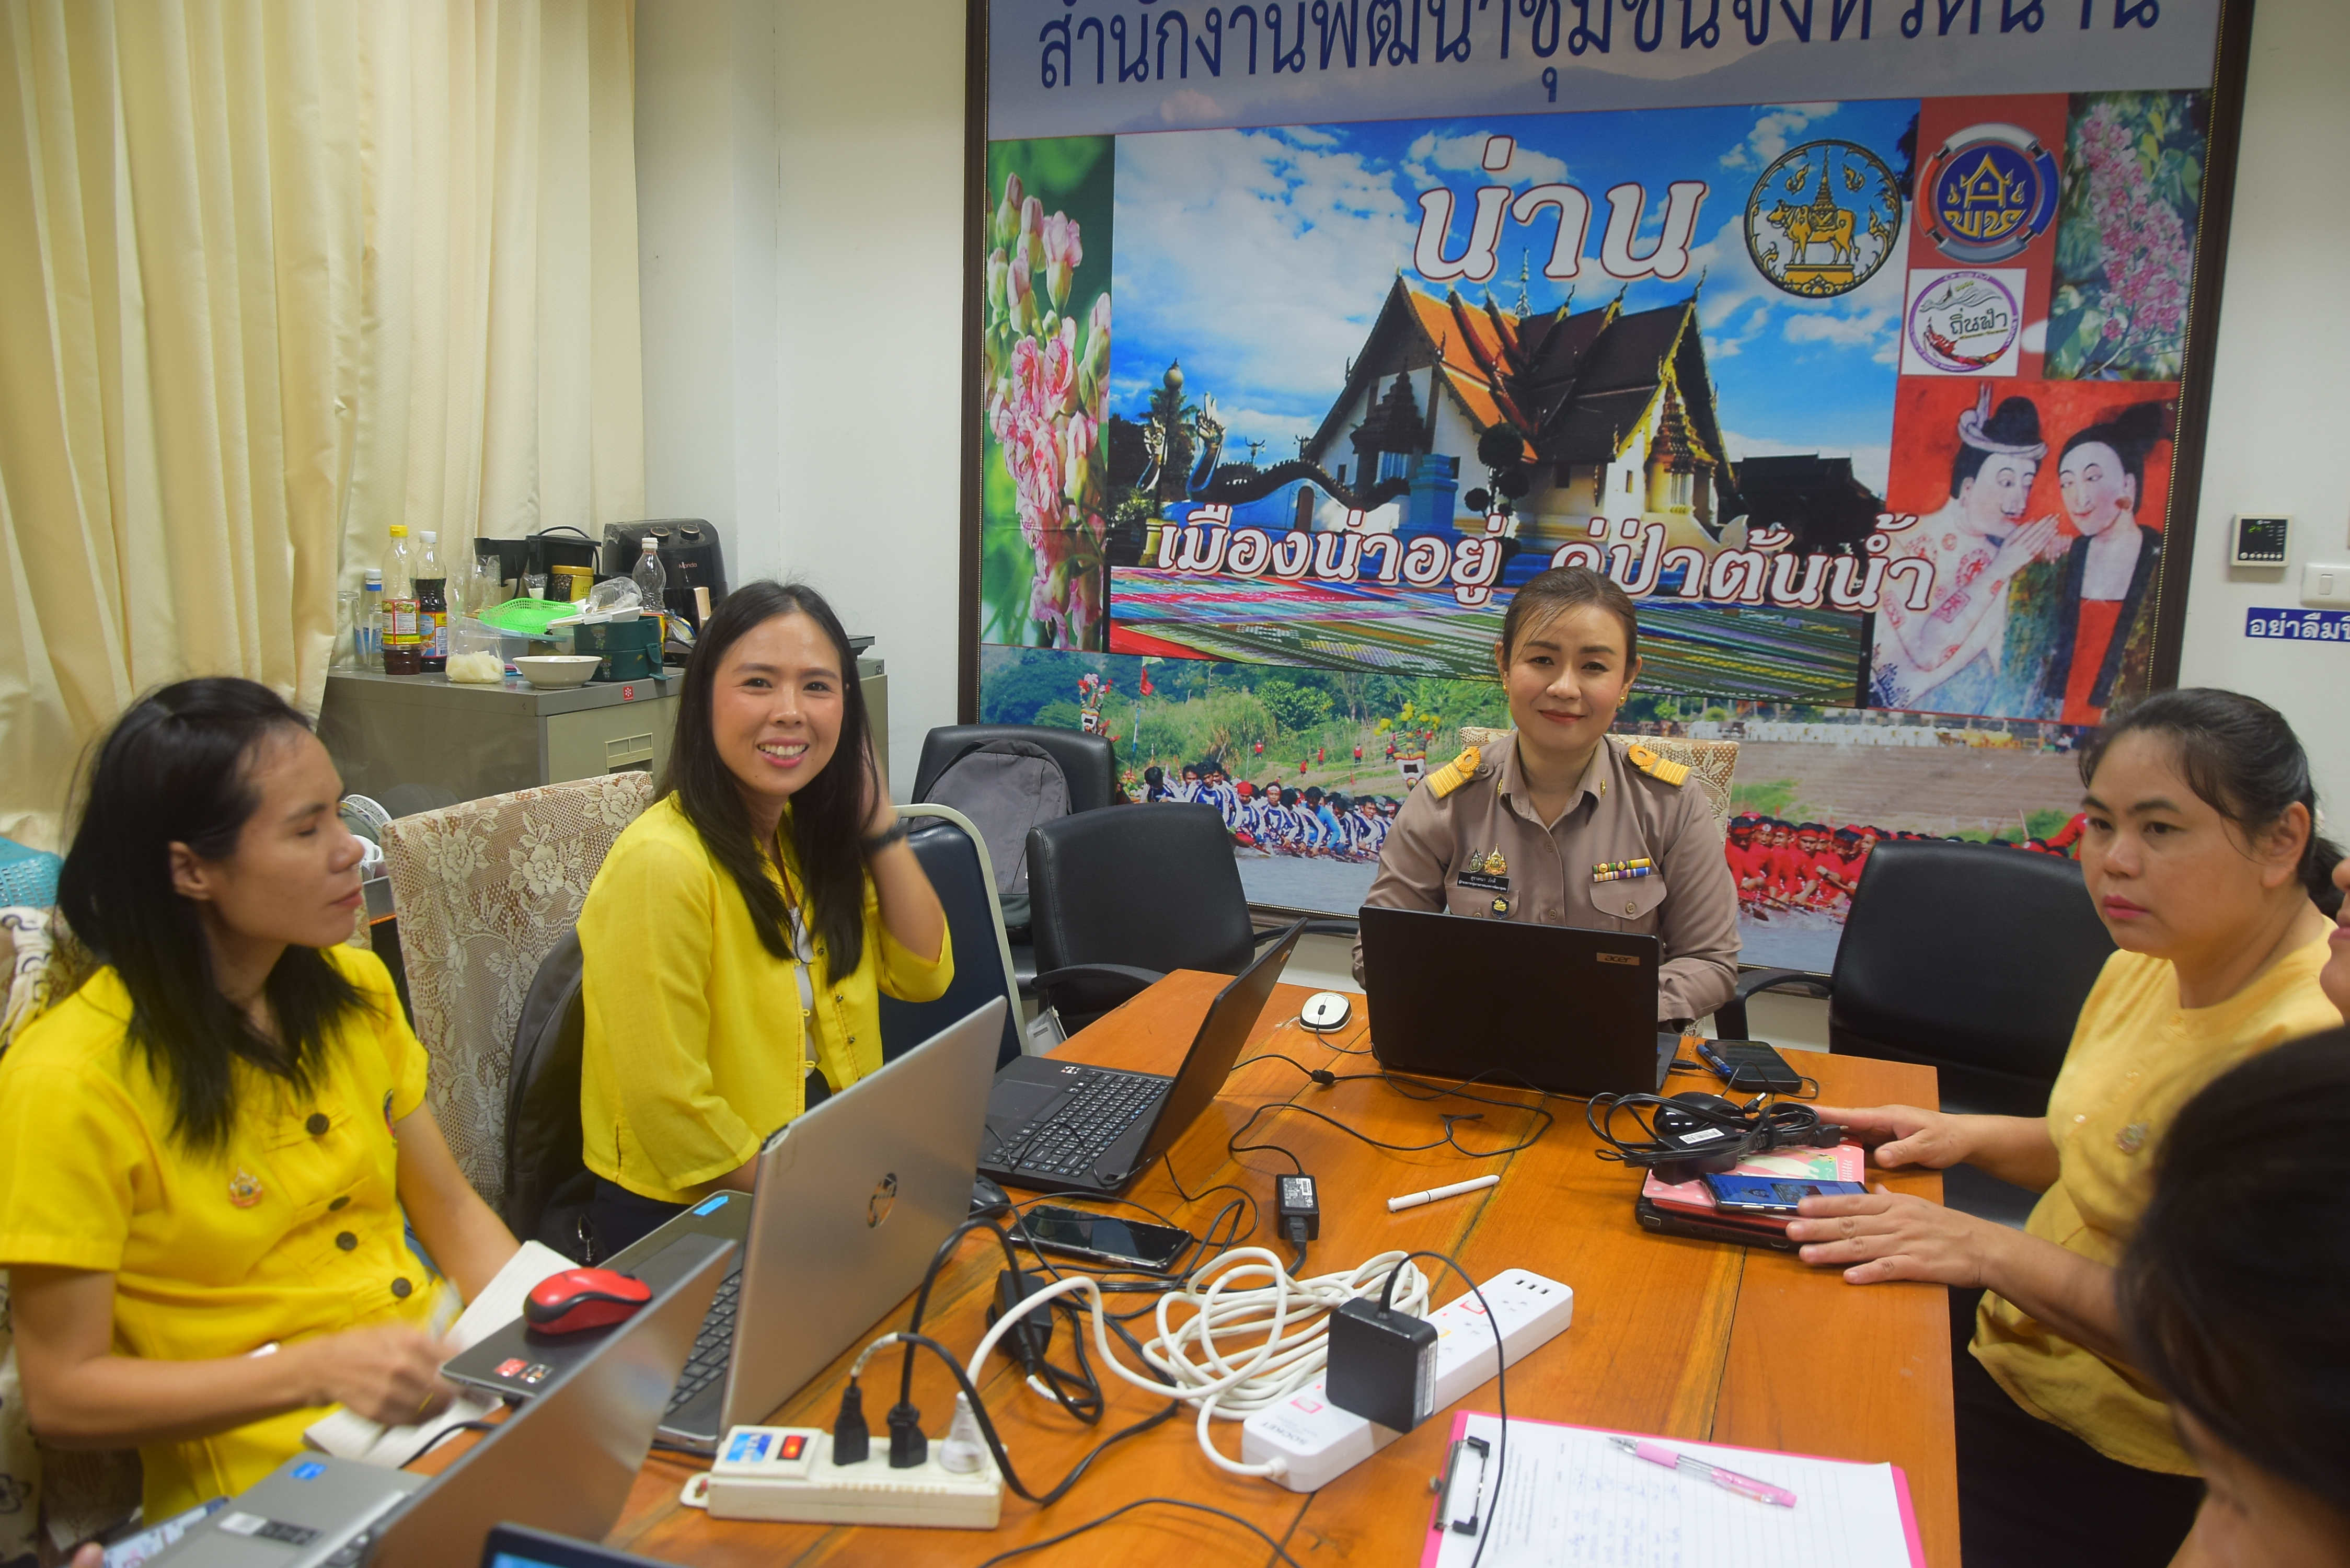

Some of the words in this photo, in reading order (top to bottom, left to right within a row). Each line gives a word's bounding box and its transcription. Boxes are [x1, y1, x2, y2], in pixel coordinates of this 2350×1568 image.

[1414, 135, 1709, 281] น่าน
[1157, 503, 1507, 607] เมืองน่าอยู่
[1550, 513, 1937, 613] ่ป่าต้นน้ำ
[1605, 955, 1631, 963] acer
